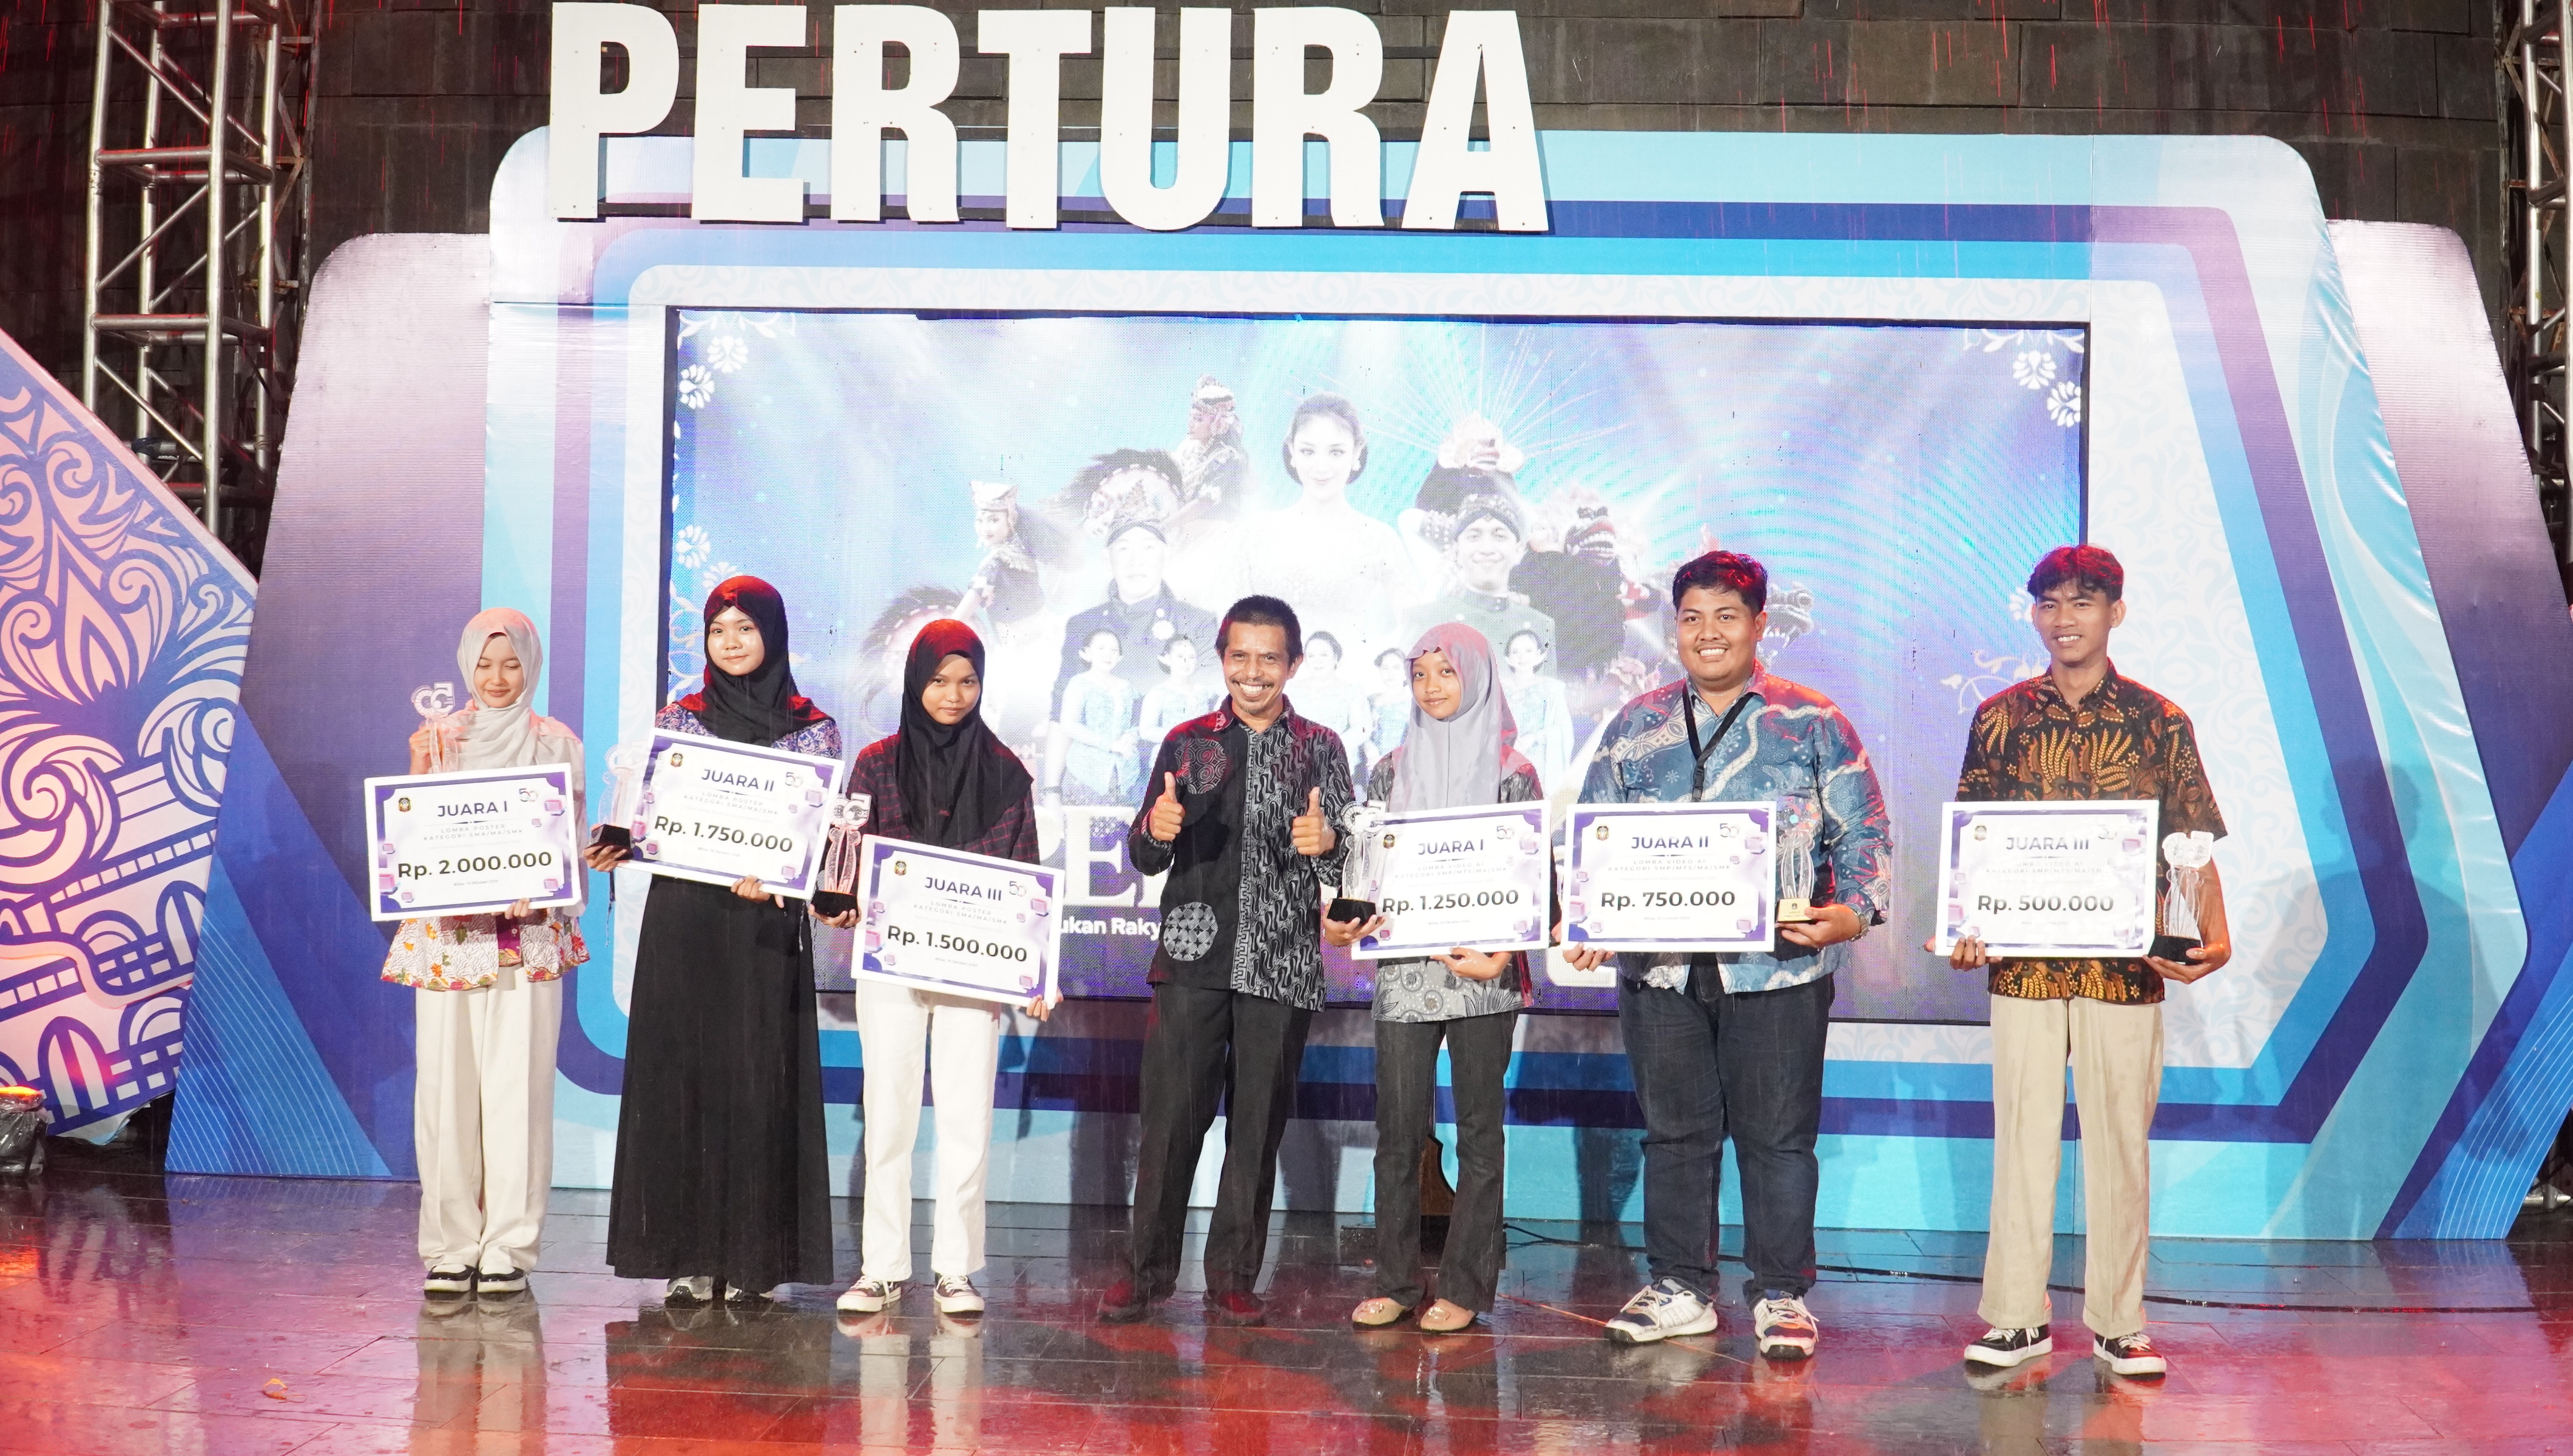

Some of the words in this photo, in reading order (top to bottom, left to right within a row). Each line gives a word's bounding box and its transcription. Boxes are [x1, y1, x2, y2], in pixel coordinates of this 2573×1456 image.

[550, 2, 1549, 231] PERTURA
[702, 769, 759, 789] JUARA
[764, 780, 774, 792] II
[438, 801, 498, 817] JUARA
[504, 800, 507, 812] I
[702, 792, 729, 800] LOMBA
[733, 797, 763, 806] POSTER
[654, 815, 686, 835] Rp.
[694, 822, 793, 852] 1.750.000
[1631, 836, 1693, 849] JUARA
[1699, 836, 1708, 848] II
[2006, 837, 2068, 850] JUARA
[2074, 838, 2089, 850] III
[1418, 841, 1475, 855] JUARA
[1480, 839, 1484, 851] I
[398, 863, 432, 880] Rp.
[439, 852, 552, 875] 2.000.000
[925, 877, 982, 898] JUARA
[987, 888, 1002, 901] III
[931, 901, 958, 909] LOMBA
[1382, 898, 1413, 915] Rp.
[1420, 890, 1519, 910] 1.250.000
[1601, 892, 1635, 911] Rp.
[1643, 891, 1735, 907] 750.000
[1978, 895, 2012, 915] Rp.
[2018, 895, 2114, 911] 500.000
[887, 925, 919, 946] Rp.
[926, 932, 1027, 962] 1.500.000
